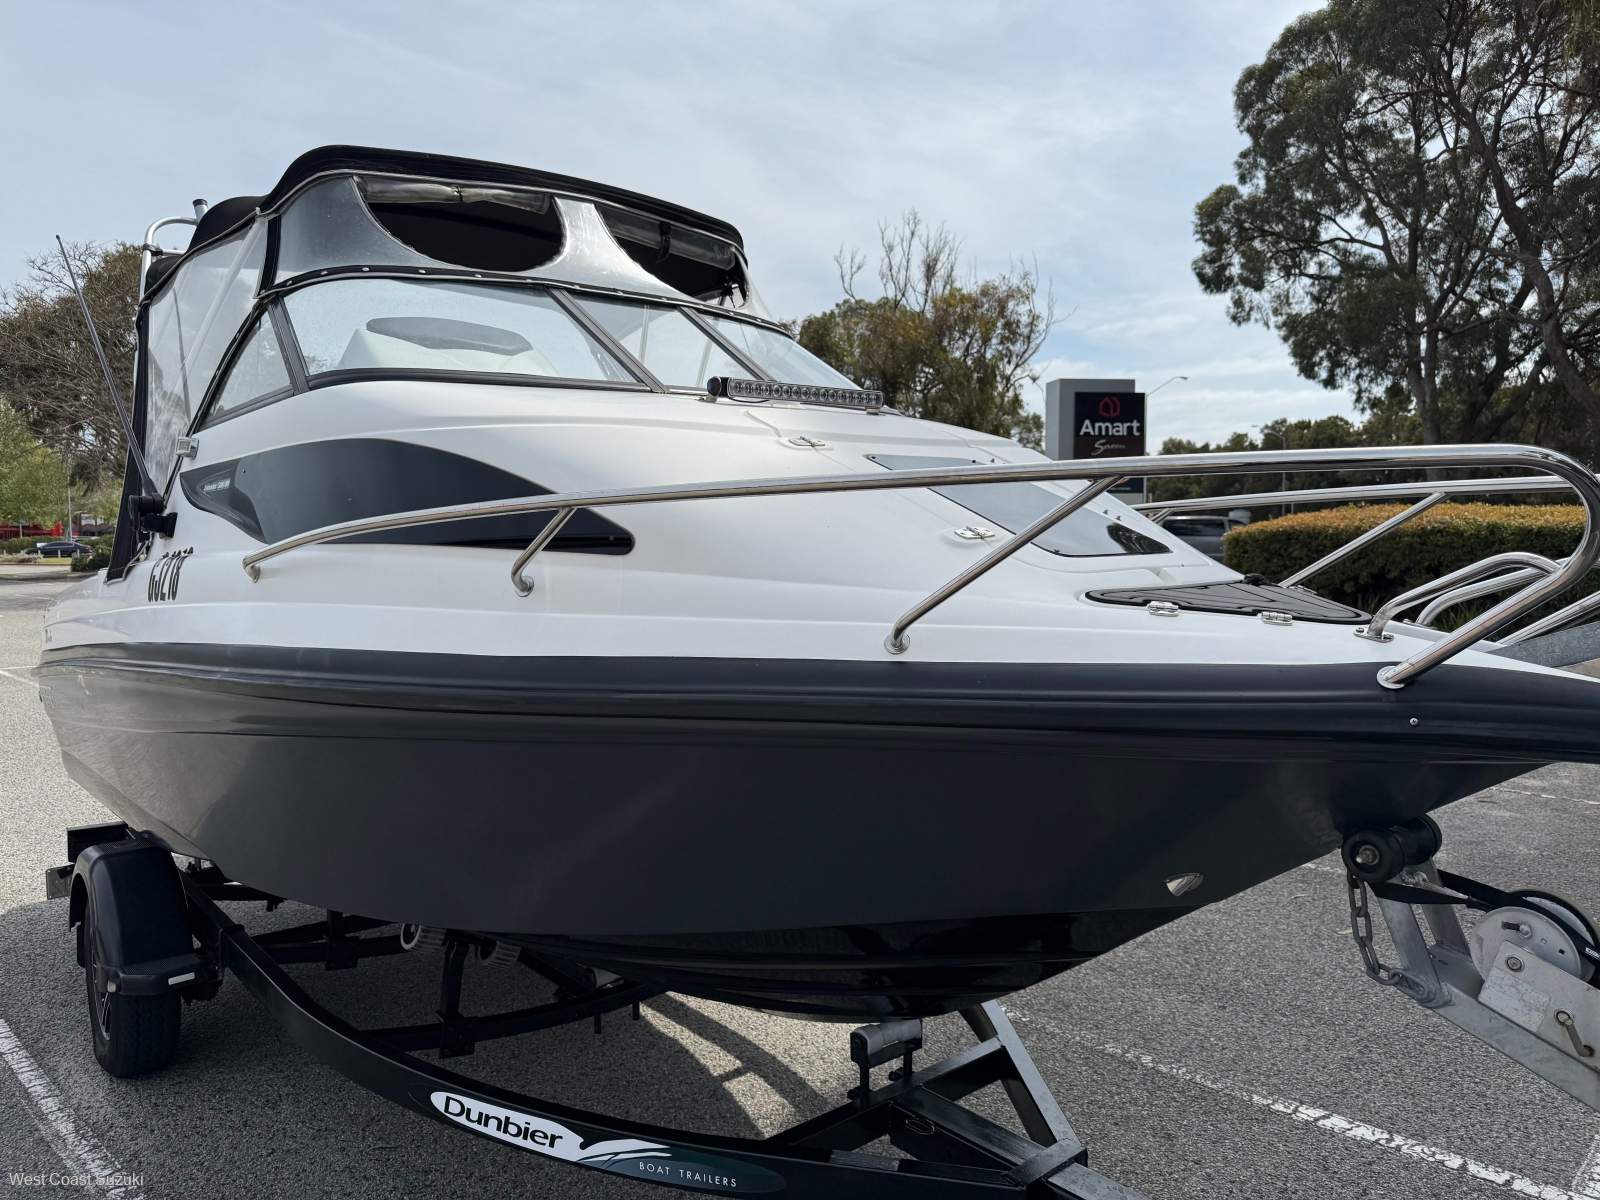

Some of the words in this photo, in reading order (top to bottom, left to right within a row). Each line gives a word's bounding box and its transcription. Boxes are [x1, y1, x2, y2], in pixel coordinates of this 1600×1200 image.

[1079, 418, 1140, 436] Amart
[443, 1095, 564, 1149] Dunbier
[639, 1161, 671, 1176] BOAT
[679, 1169, 737, 1188] TRAILERS
